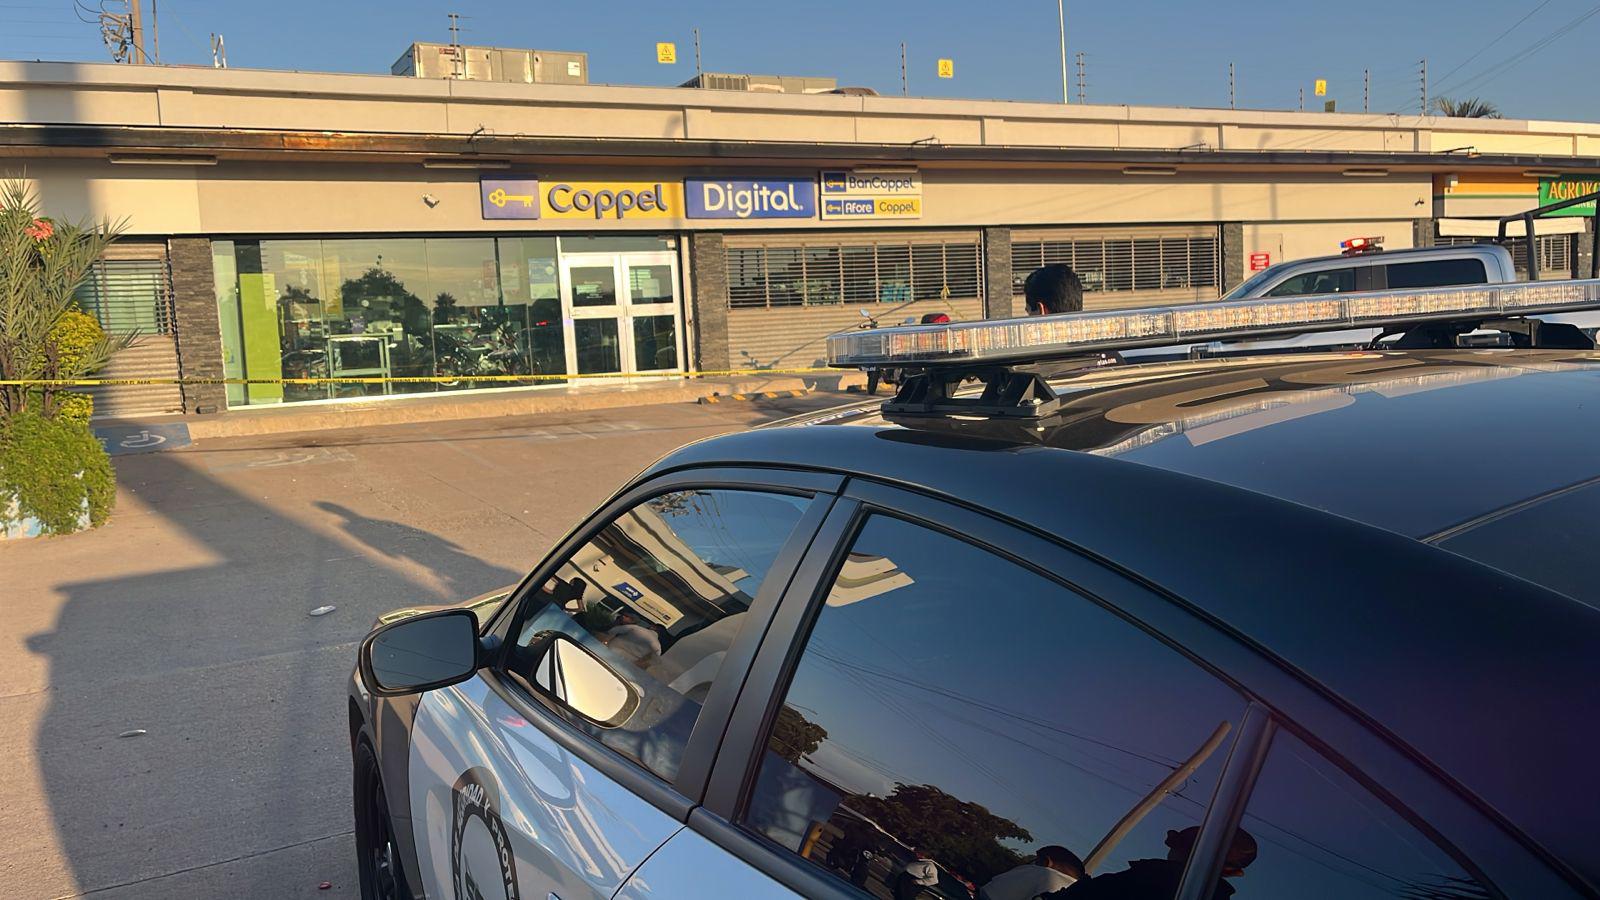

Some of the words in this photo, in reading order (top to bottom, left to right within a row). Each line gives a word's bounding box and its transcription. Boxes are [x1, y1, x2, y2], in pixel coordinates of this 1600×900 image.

[849, 177, 915, 192] BanCoppel
[548, 184, 668, 219] Coppel
[845, 202, 873, 214] Afore
[879, 201, 915, 214] Coppel
